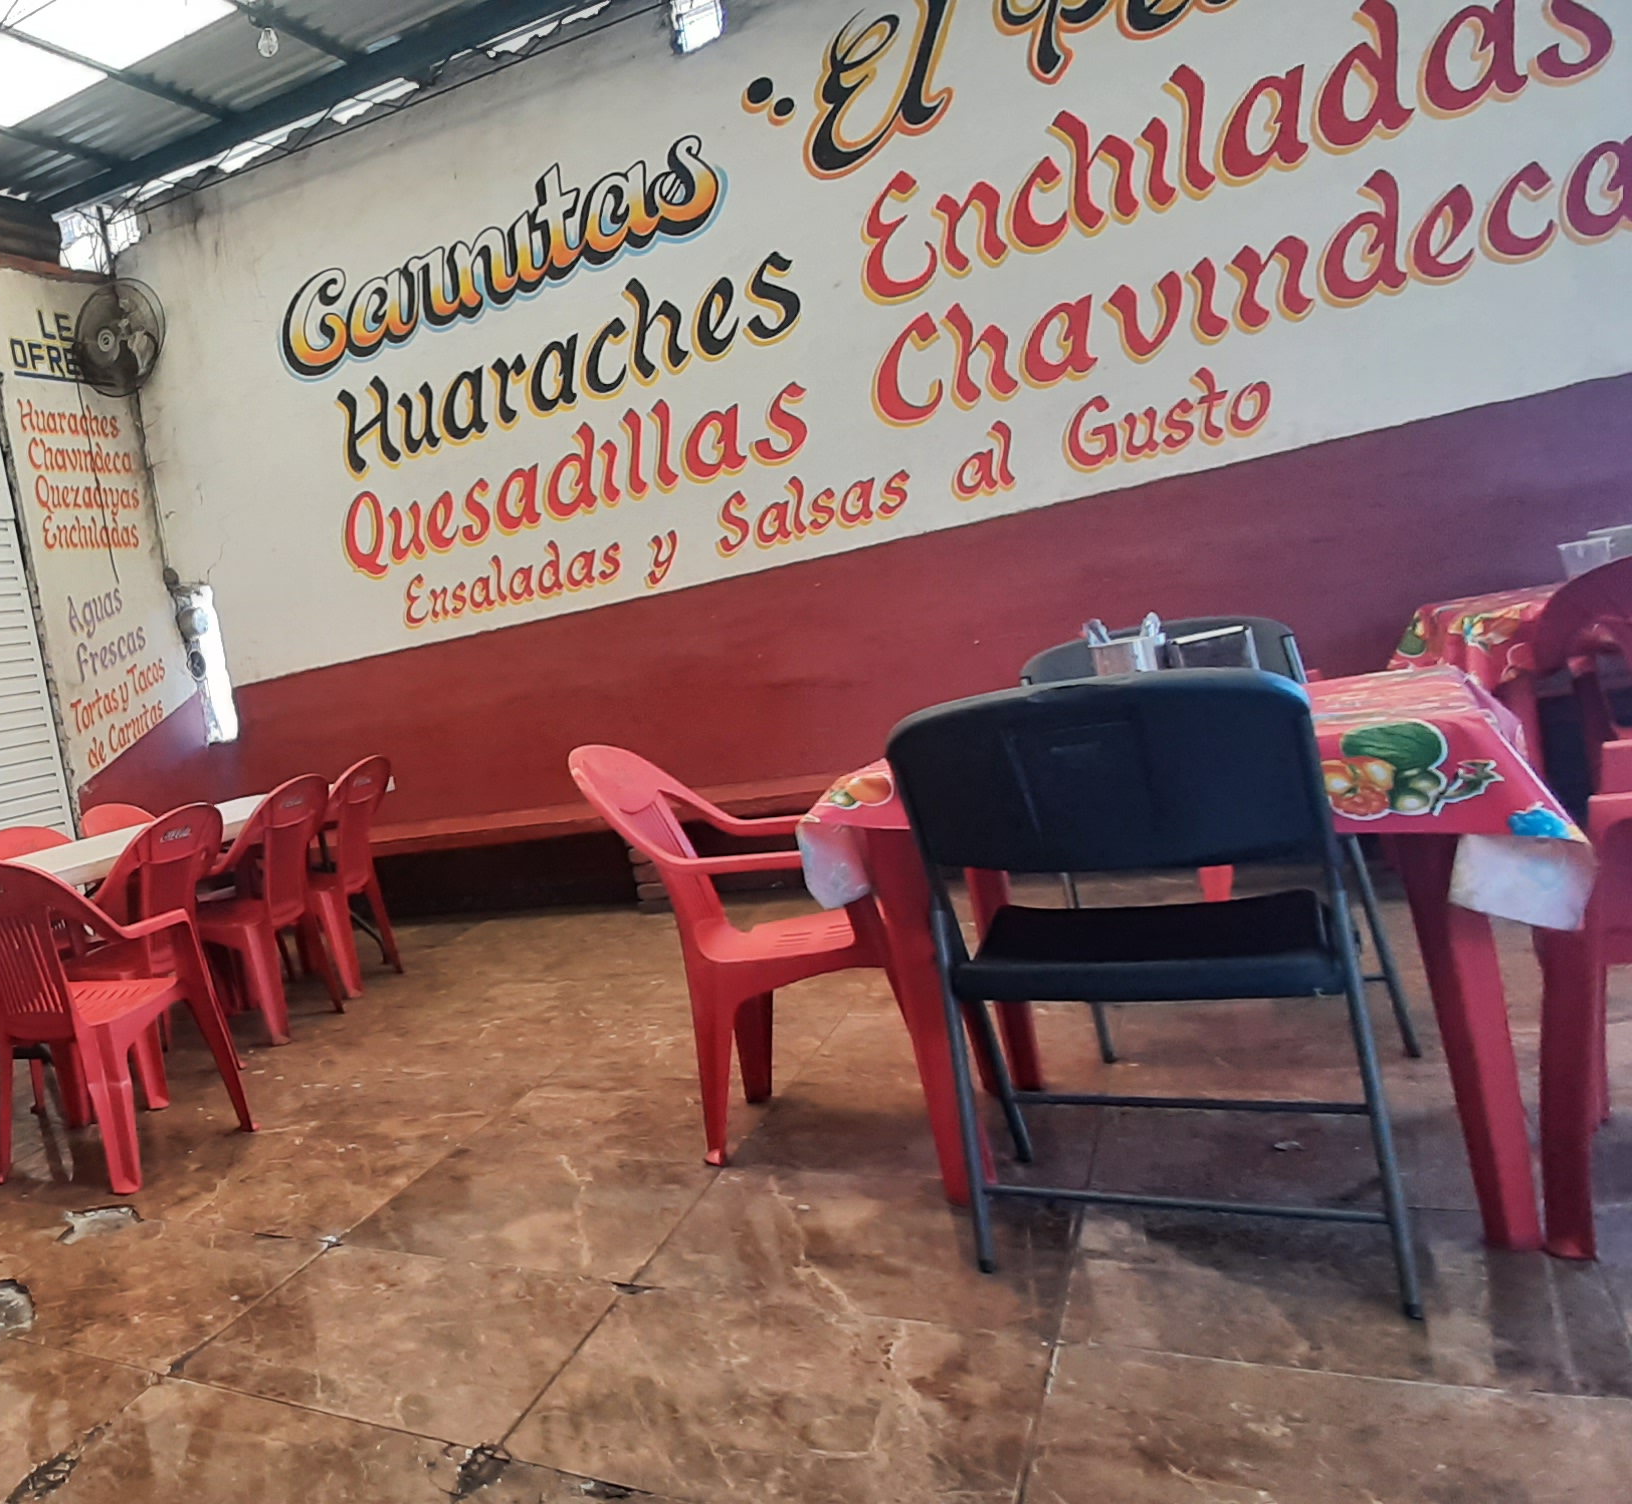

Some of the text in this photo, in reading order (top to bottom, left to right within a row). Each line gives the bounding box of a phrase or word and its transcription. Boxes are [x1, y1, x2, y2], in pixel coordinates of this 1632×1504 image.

[279, 134, 726, 382] Carnitas
[337, 0, 1614, 480] Huaraches Enchiladas
[342, 135, 1632, 577] Quesadillas Chavindeca
[17, 399, 120, 438] Huaraches
[28, 437, 133, 473] Chavindeca
[35, 475, 140, 516] Quezadiyas
[403, 366, 1271, 628] Ensaladas y Salsas al Gusto
[43, 516, 140, 550] Enchiladas
[68, 588, 123, 638] Aguas
[71, 658, 166, 734] Tortas y Tacos
[87, 700, 164, 768] de Carnitas
